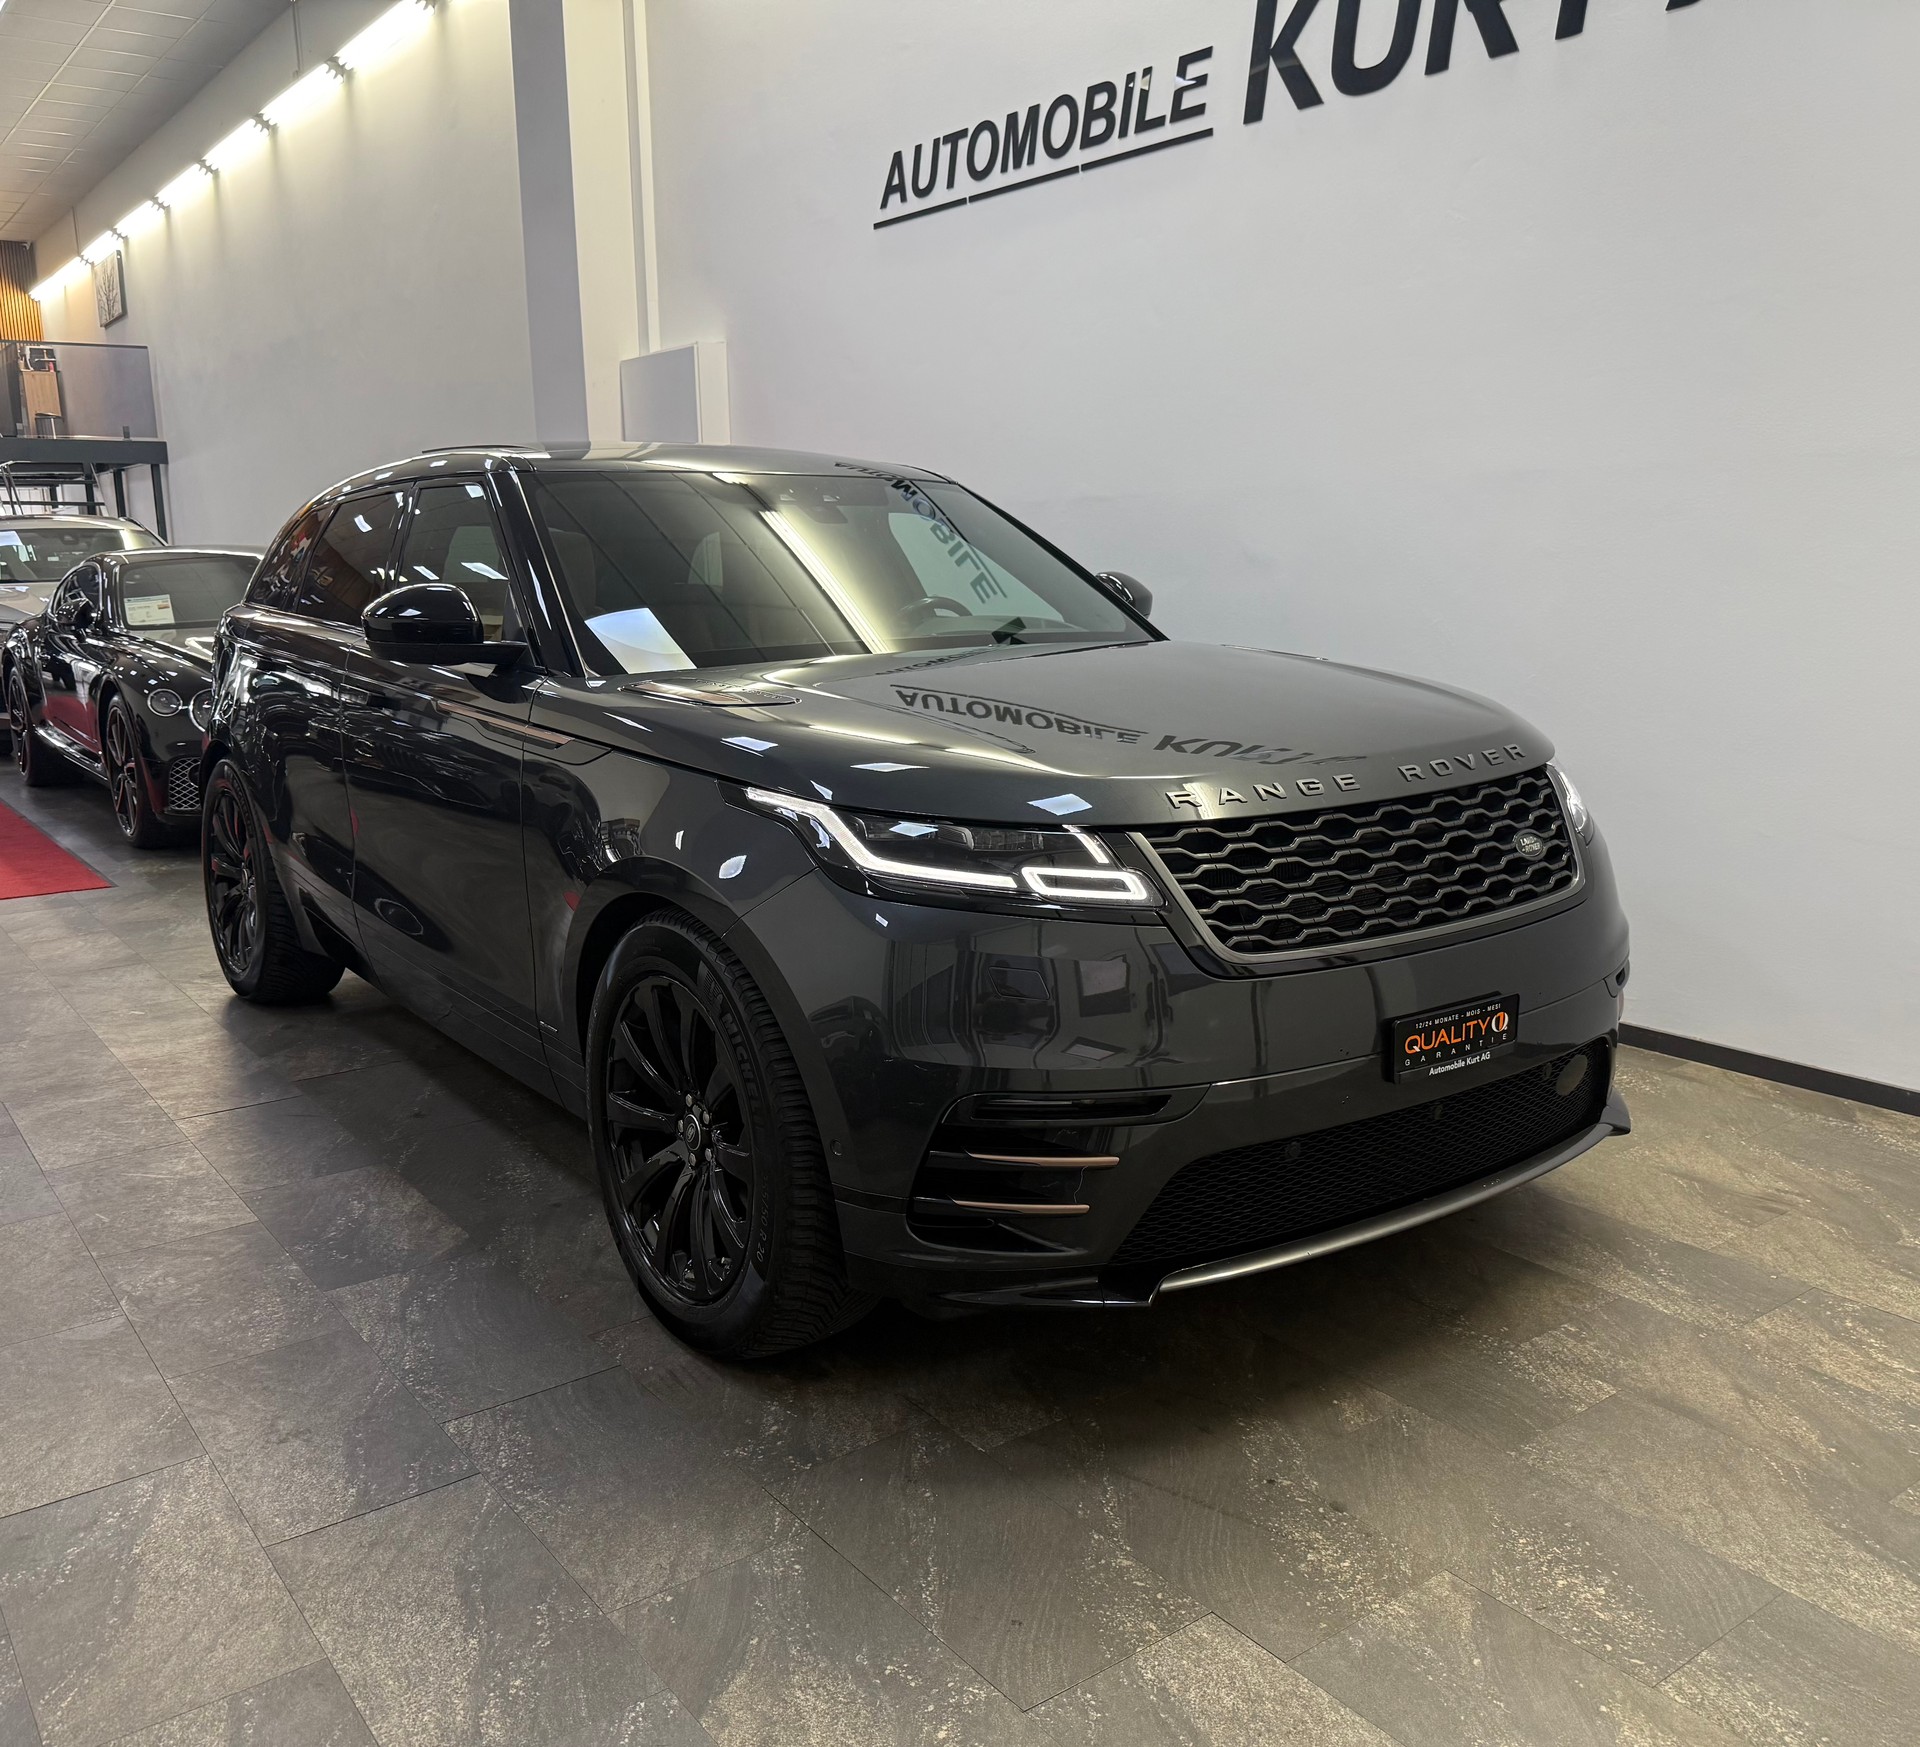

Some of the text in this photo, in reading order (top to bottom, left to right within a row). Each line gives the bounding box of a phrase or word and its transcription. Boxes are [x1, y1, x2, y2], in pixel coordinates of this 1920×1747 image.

[879, 46, 1214, 210] AUTOMOBILE
[1165, 743, 1527, 809] RANGE ROVER
[1415, 1020, 1433, 1029] 12/24
[1434, 1013, 1459, 1025] MONATE
[1466, 1008, 1481, 1018] MOIS
[1487, 1003, 1501, 1012] MESI
[1404, 1016, 1491, 1054] QUALITY
[1404, 1033, 1507, 1066] GARANTIE
[1428, 1051, 1491, 1076] Automobile Kurt AG
